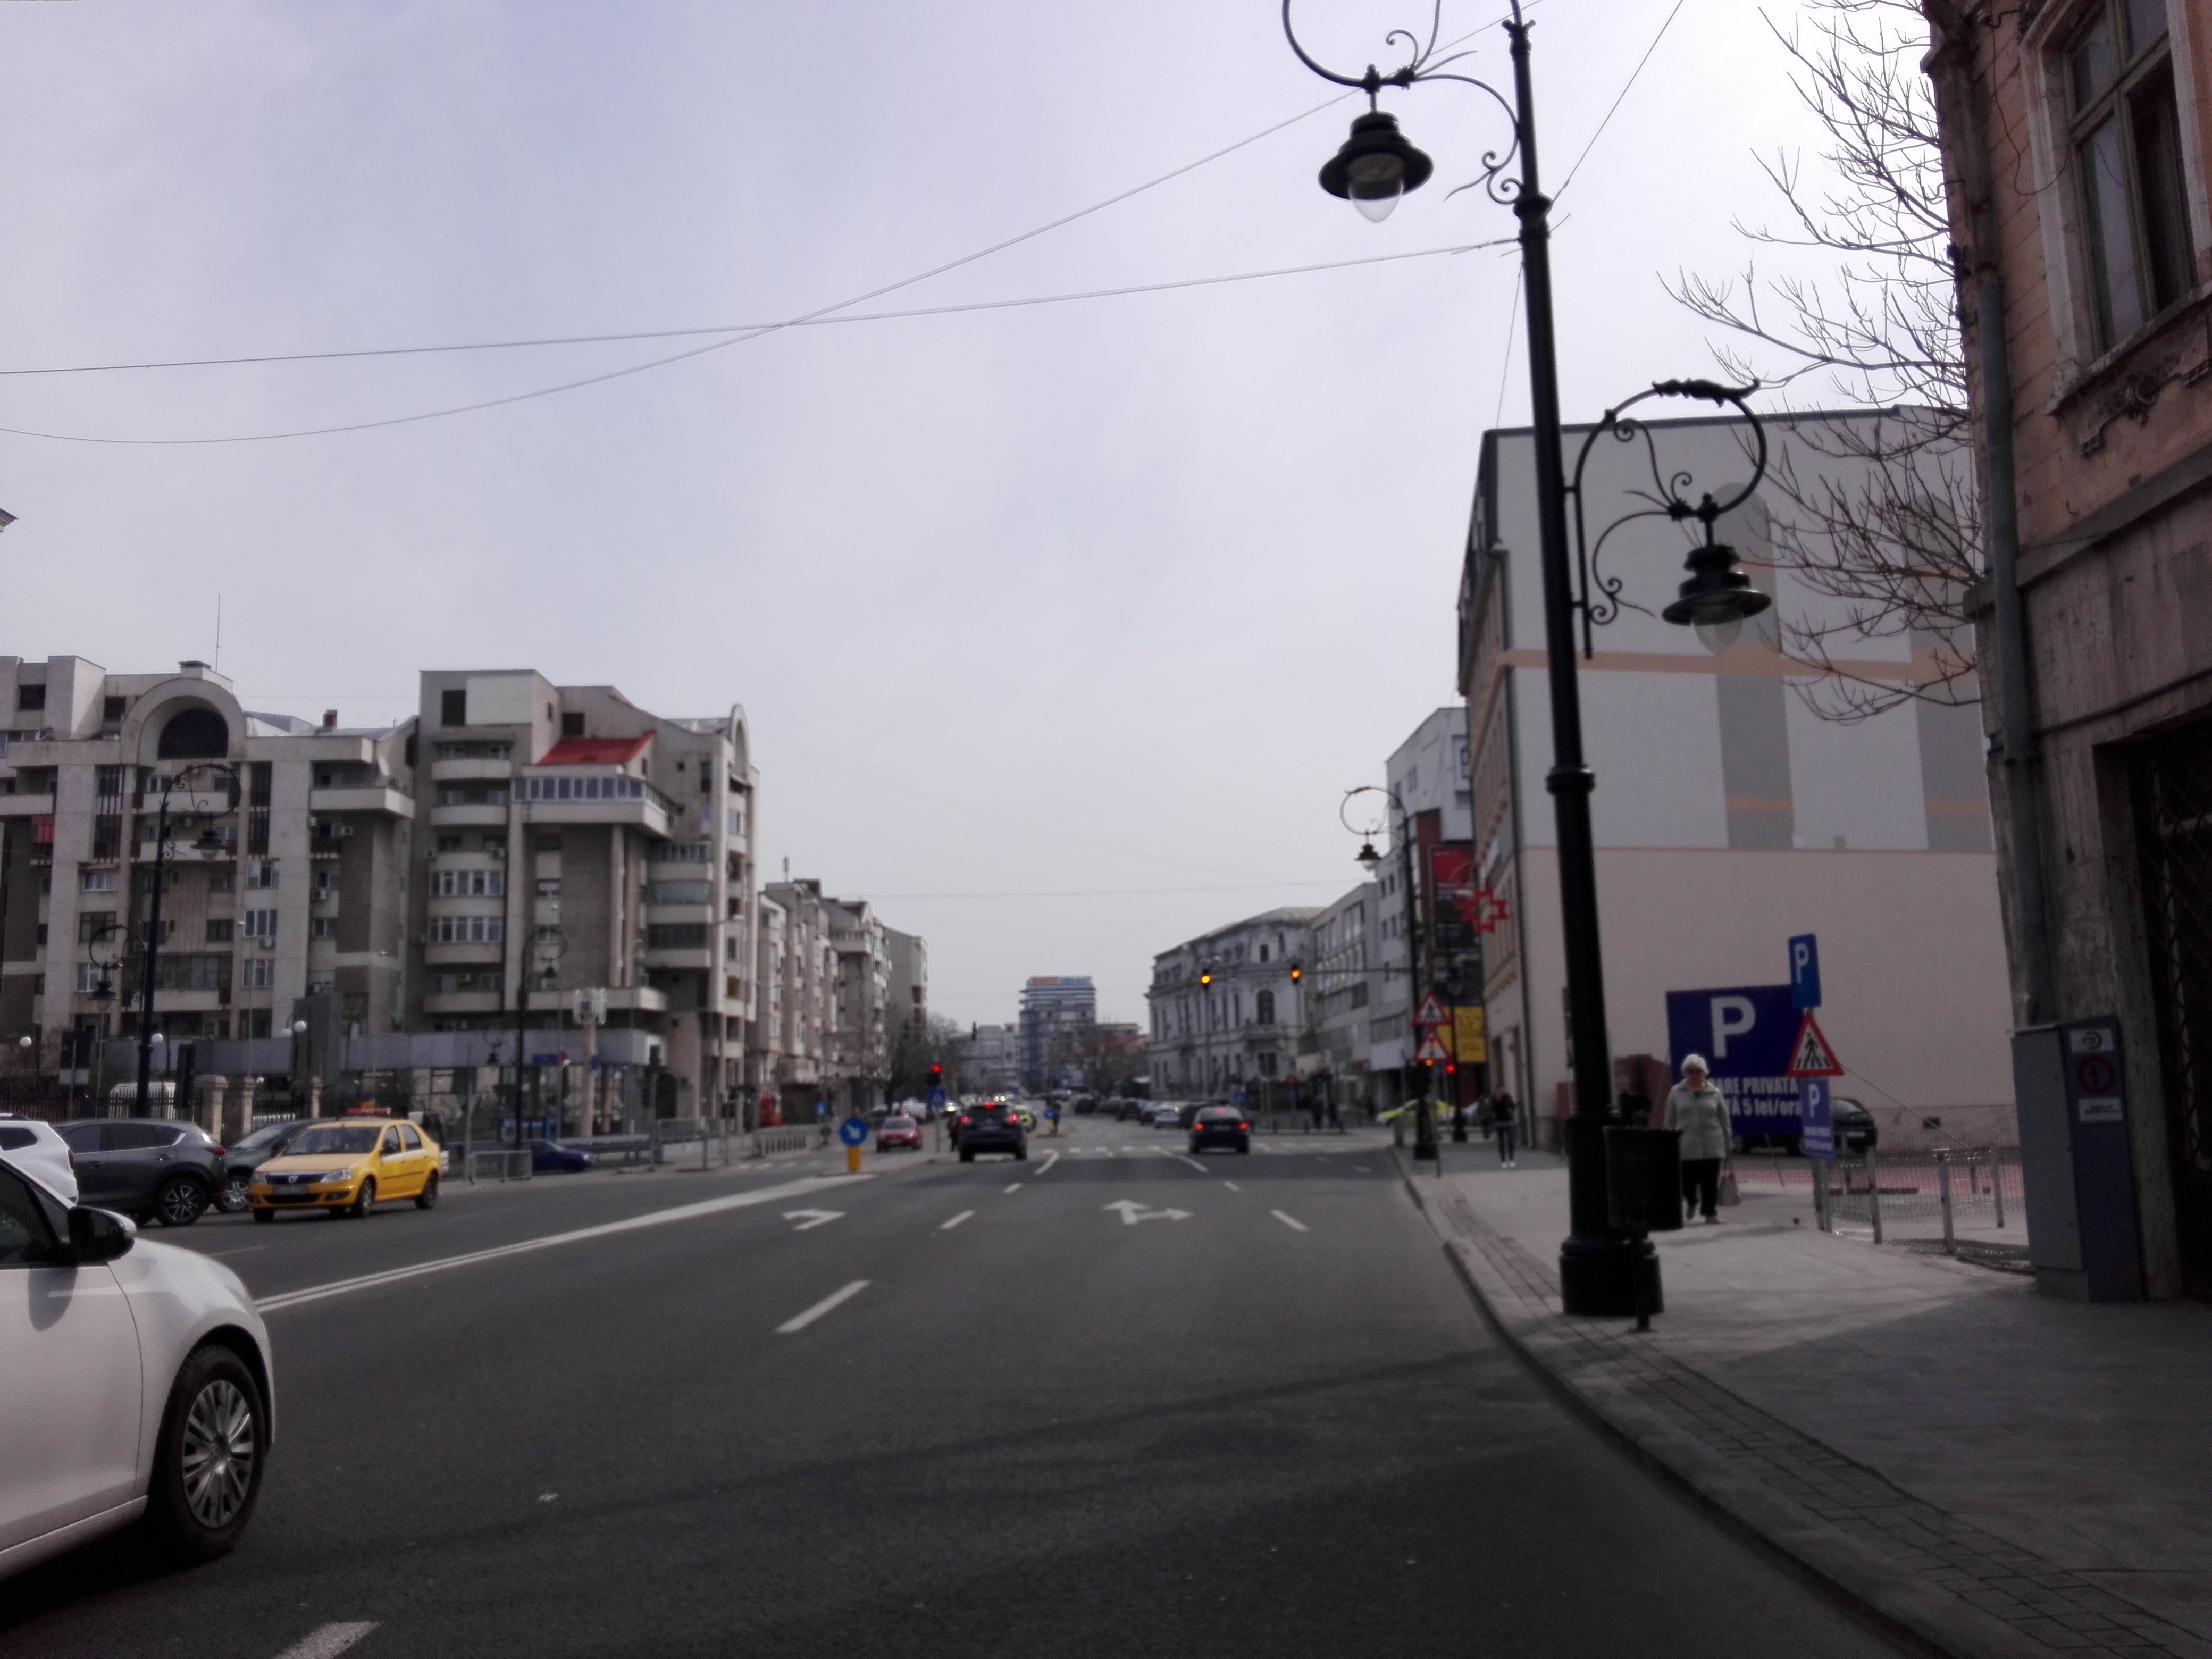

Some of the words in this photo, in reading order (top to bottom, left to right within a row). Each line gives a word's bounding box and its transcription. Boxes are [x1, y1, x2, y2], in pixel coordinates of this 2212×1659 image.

[1794, 943, 1809, 984] P
[1710, 996, 1756, 1058] P
[1742, 1099, 1753, 1116] 5
[1809, 1084, 1820, 1117] P
